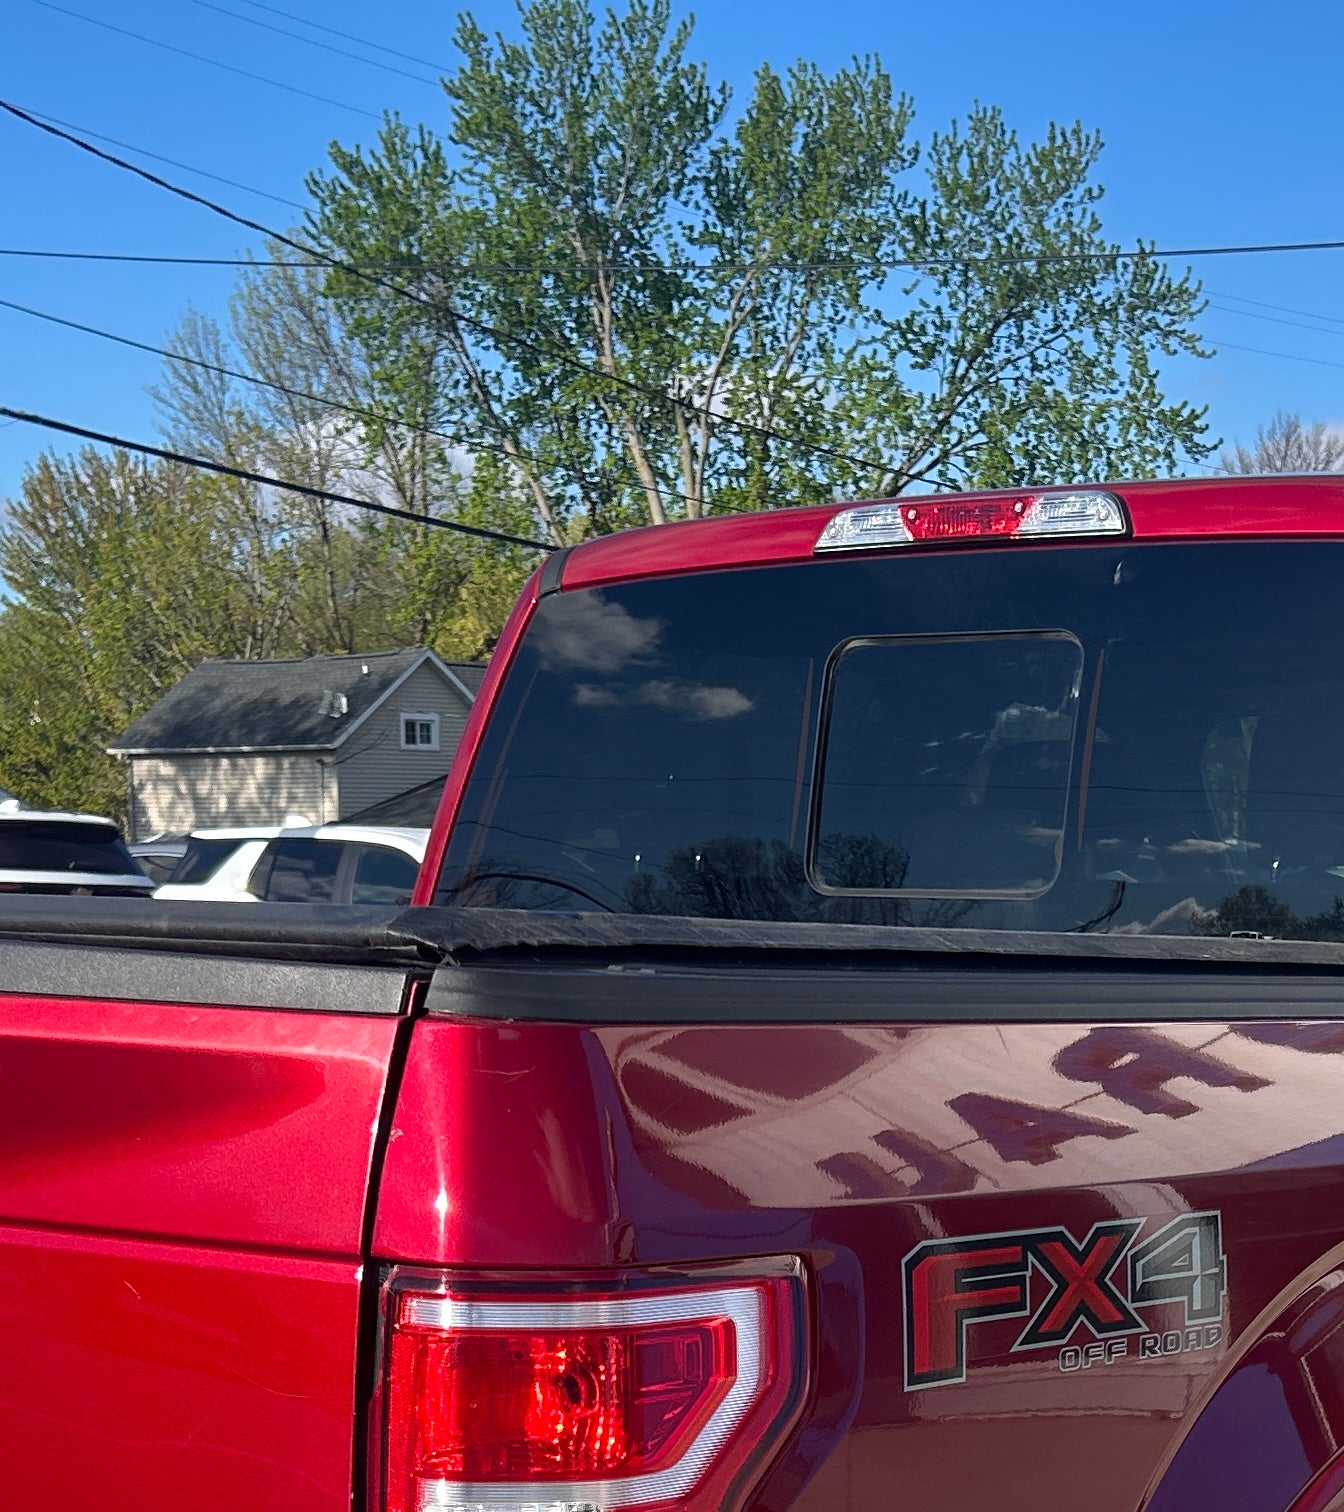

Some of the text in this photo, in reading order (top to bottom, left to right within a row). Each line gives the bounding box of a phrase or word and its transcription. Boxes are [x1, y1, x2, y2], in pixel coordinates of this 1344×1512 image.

[901, 1209, 1227, 1392] FX4
[1059, 1324, 1223, 1373] OFF ROAD
